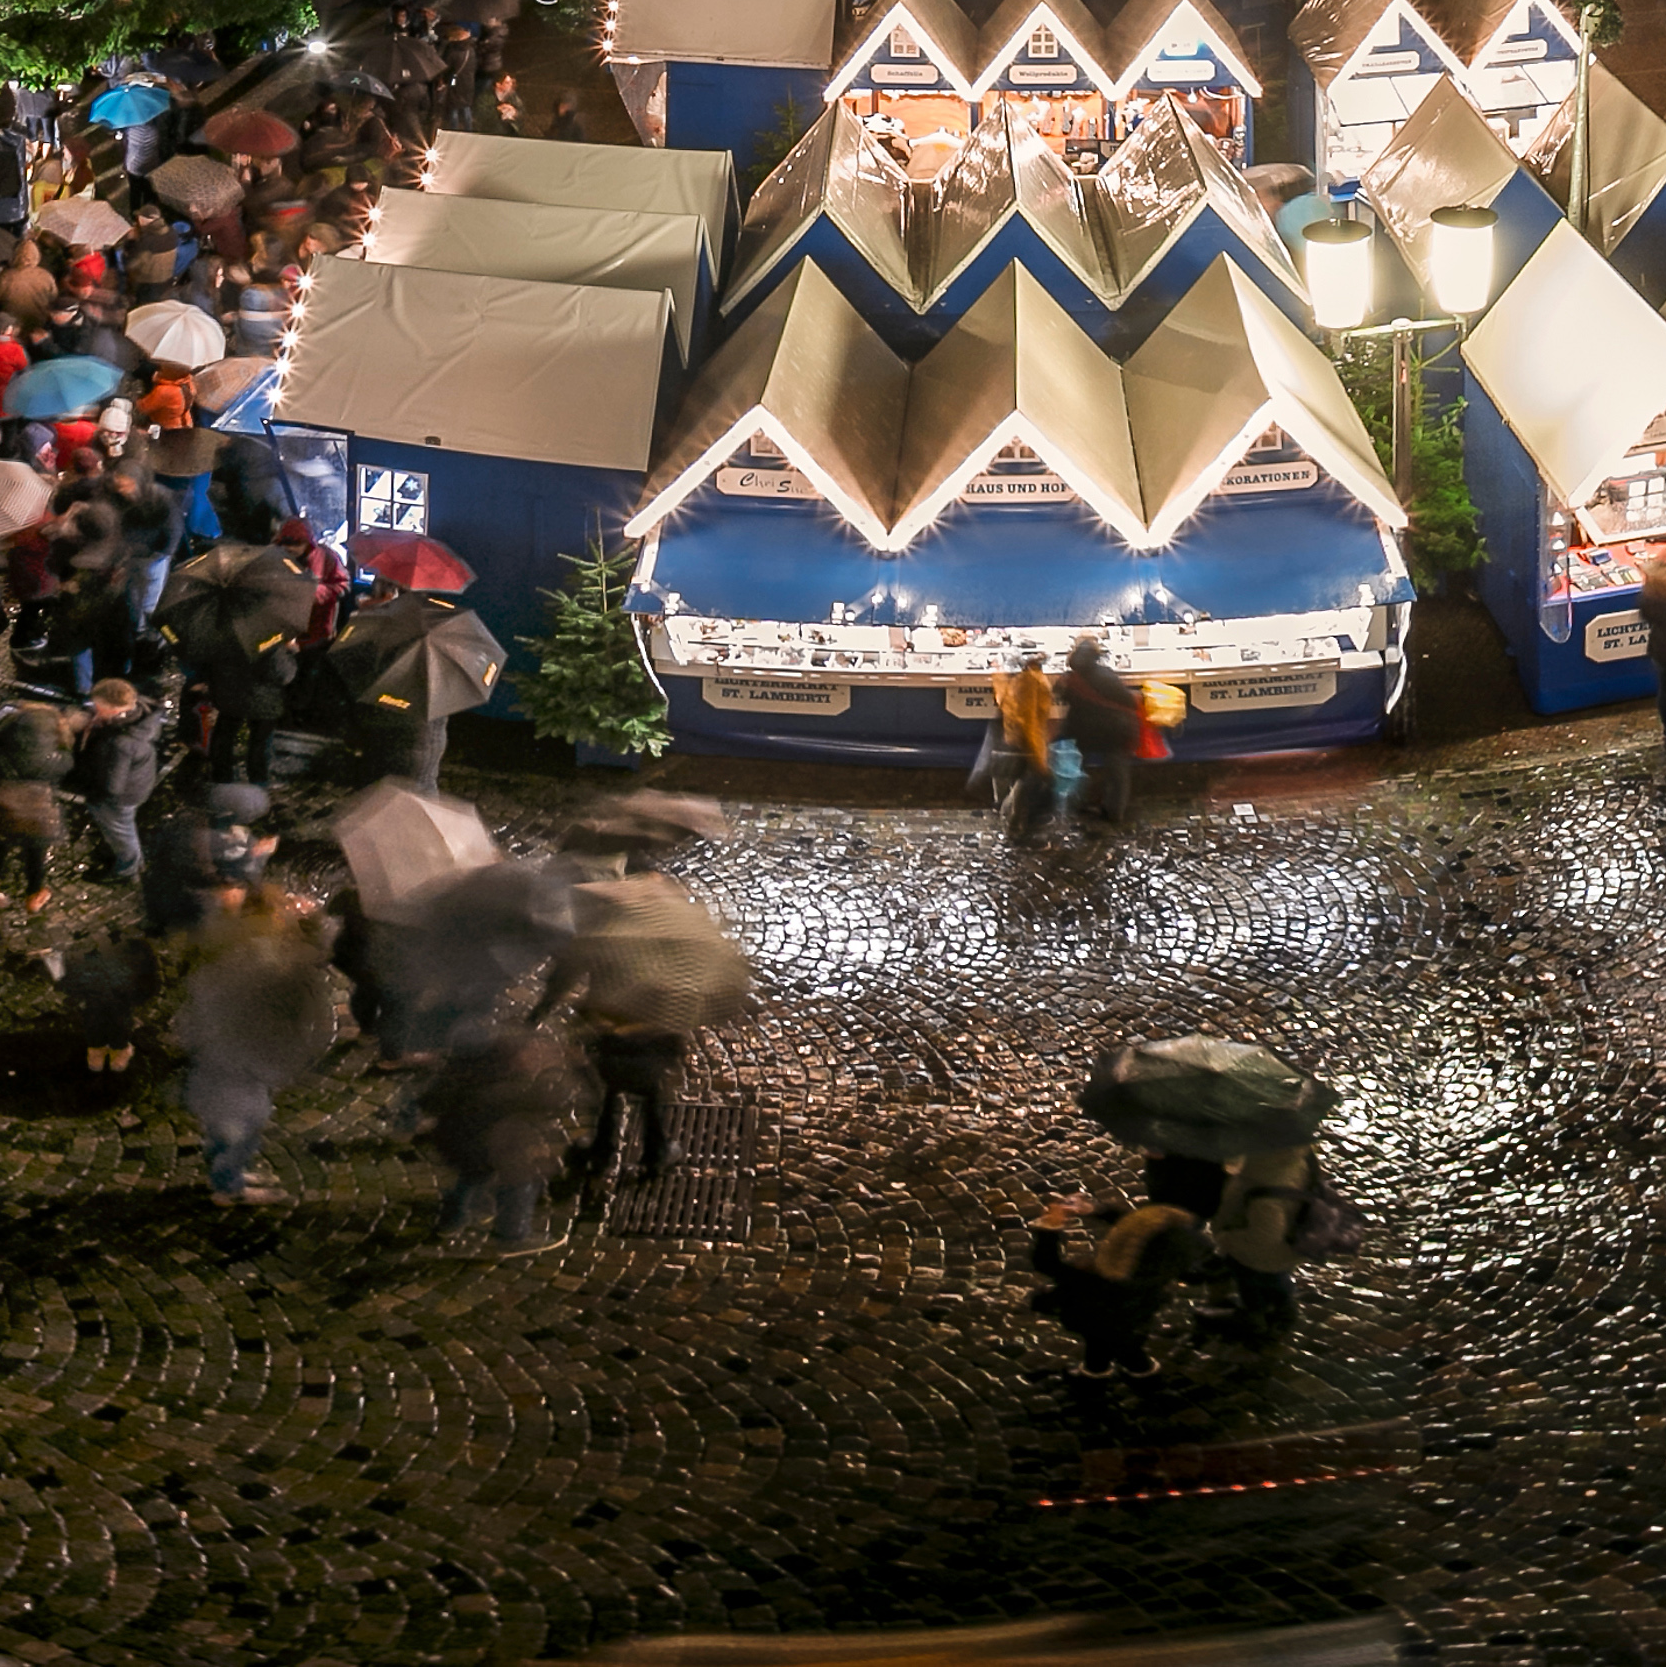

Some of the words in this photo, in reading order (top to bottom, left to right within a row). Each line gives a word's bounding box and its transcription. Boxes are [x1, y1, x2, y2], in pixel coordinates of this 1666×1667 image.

[1225, 470, 1311, 485] KORATIONEN
[1007, 483, 1038, 494] UND
[1603, 638, 1625, 650] ST.
[721, 688, 745, 698] ST.
[749, 690, 832, 704] LAMBERTI
[1209, 690, 1233, 700] ST.
[1237, 683, 1318, 699] LAMBERTI
[965, 697, 989, 708] ST.
